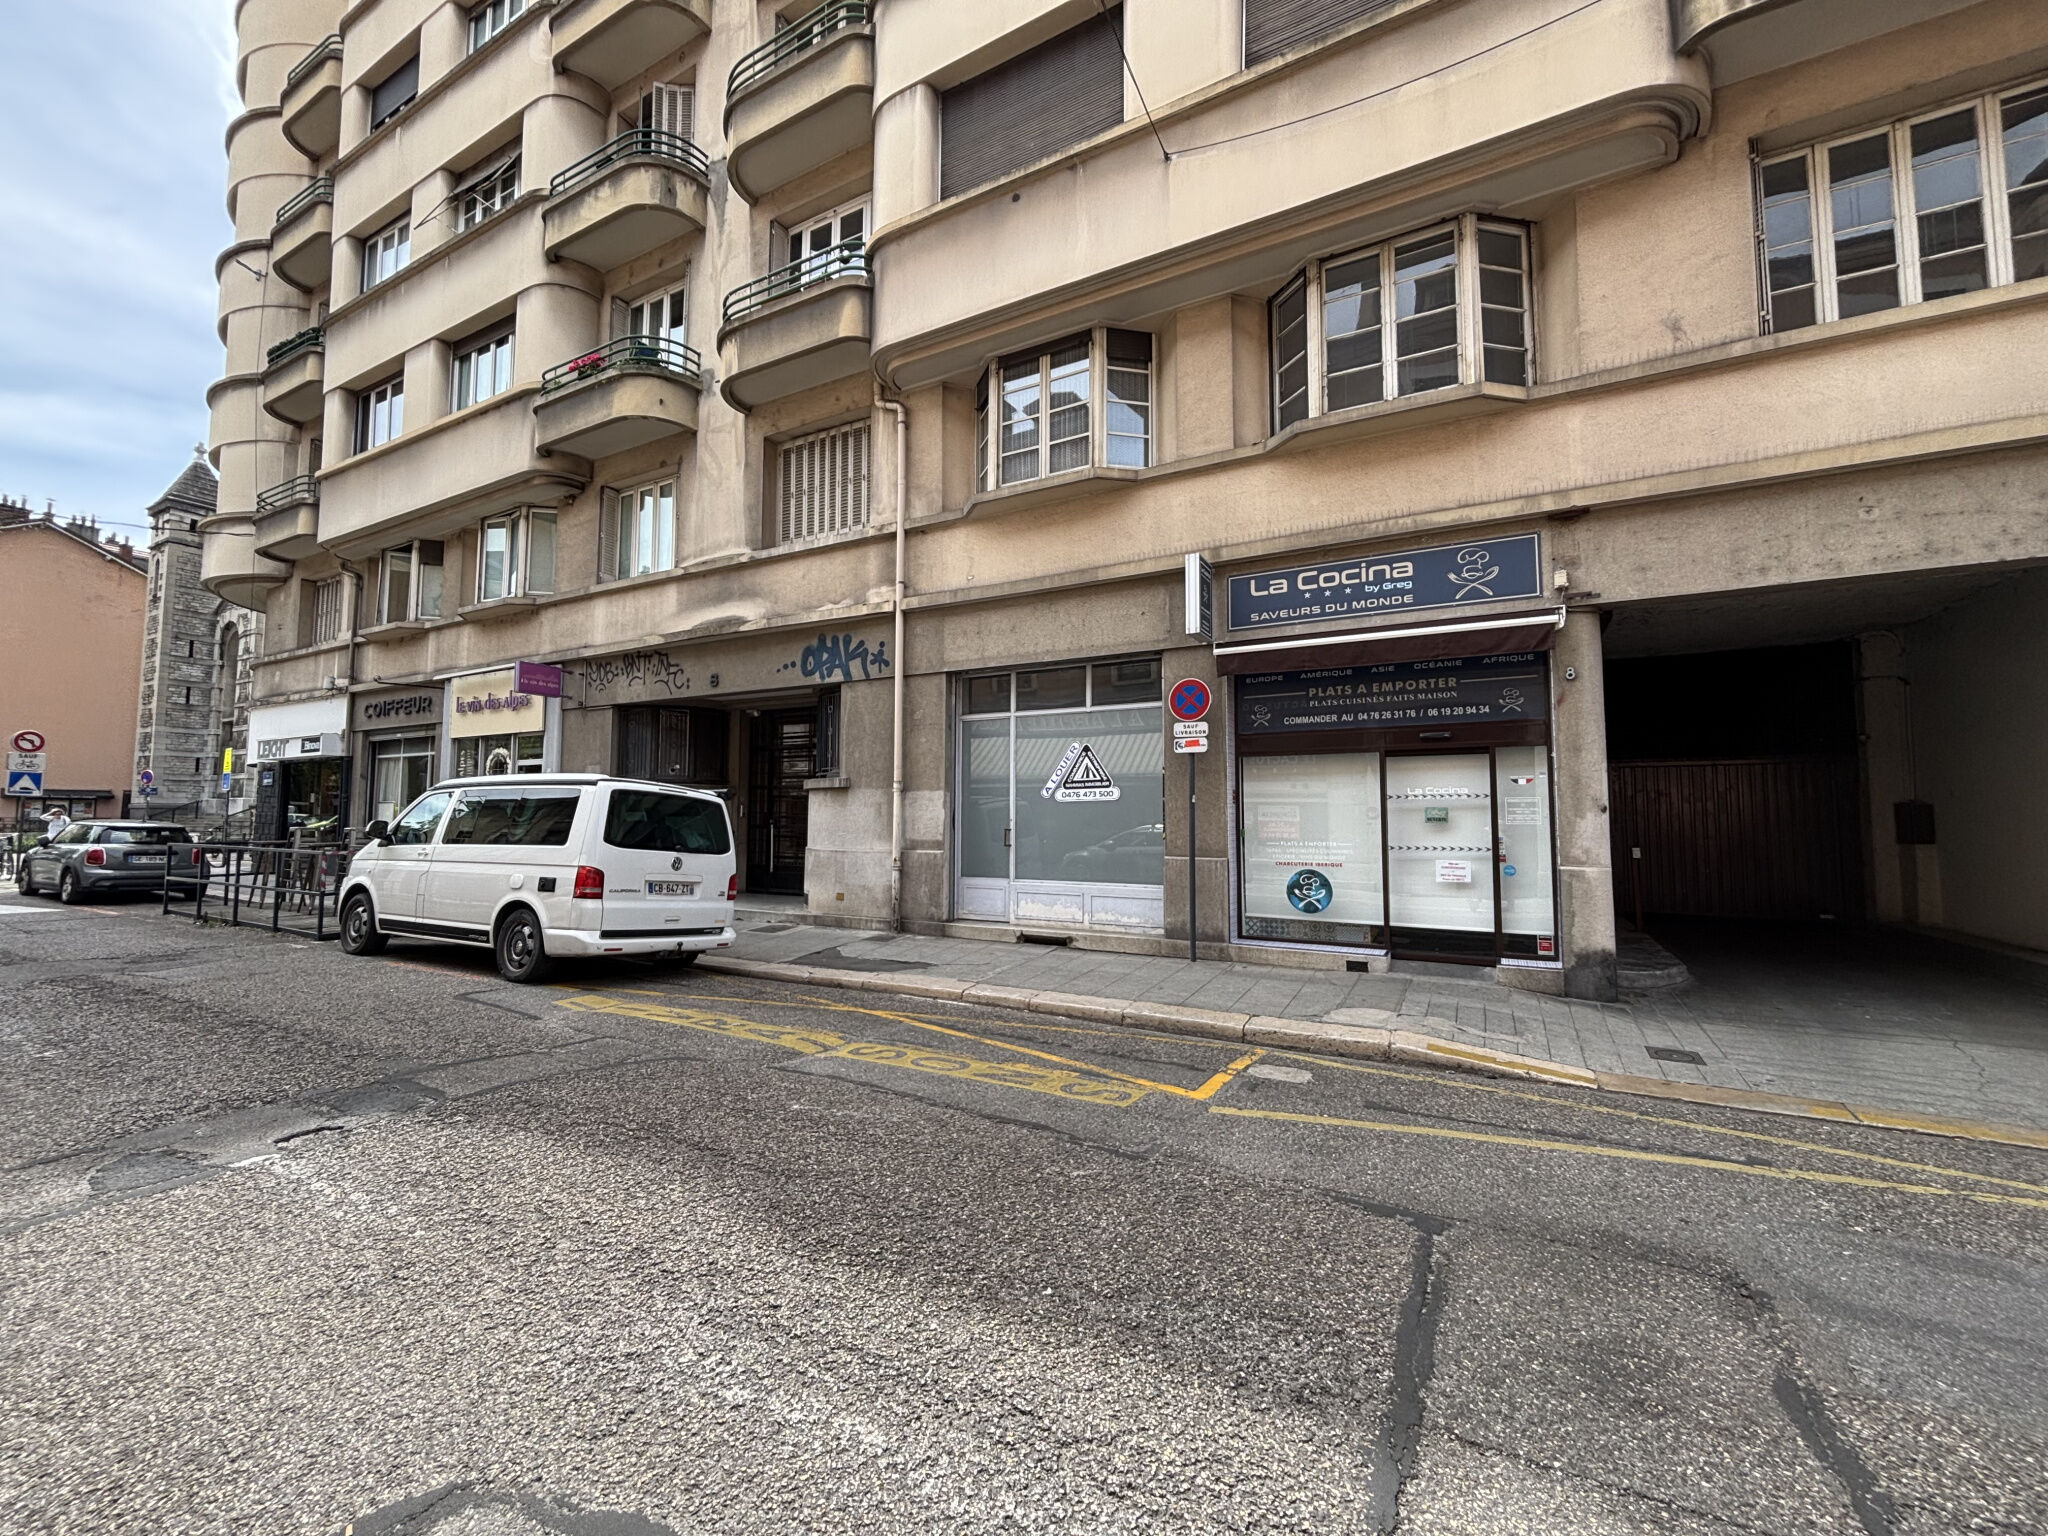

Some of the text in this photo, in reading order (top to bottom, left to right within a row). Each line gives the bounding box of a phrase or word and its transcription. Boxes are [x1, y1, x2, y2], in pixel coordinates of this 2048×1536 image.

[1250, 561, 1413, 597] La Cocina
[1365, 580, 1413, 593] by Greg
[1251, 594, 1414, 622] SAVEURS DU MONDE
[1246, 653, 1535, 684] EUROPE AMÉRIQUE ASIE OCÉANIE AFRIQUE
[1565, 666, 1576, 680] 8
[1308, 677, 1458, 698] PLATS A EMPORTER
[364, 695, 433, 719] COIFFEUR
[1309, 699, 1338, 708] PLATS
[1339, 694, 1384, 706] CUISINÉS
[1386, 693, 1415, 703] FAITS
[1417, 690, 1458, 700] MAISON
[1283, 714, 1338, 725] COMMANDER
[1341, 713, 1354, 722] AU
[1357, 712, 1368, 721] 04
[1369, 711, 1380, 720] 76
[1381, 711, 1392, 720] 26
[1393, 710, 1403, 719] 31
[1405, 709, 1416, 719] 76
[1427, 708, 1438, 717] 06
[1440, 707, 1450, 716] 19
[1453, 706, 1463, 716] 20
[1465, 706, 1476, 715] 94
[1478, 705, 1490, 714] 34
[1044, 744, 1078, 795] A LOUER
[1082, 790, 1097, 798] 473
[1407, 785, 1469, 795] La Cocina
